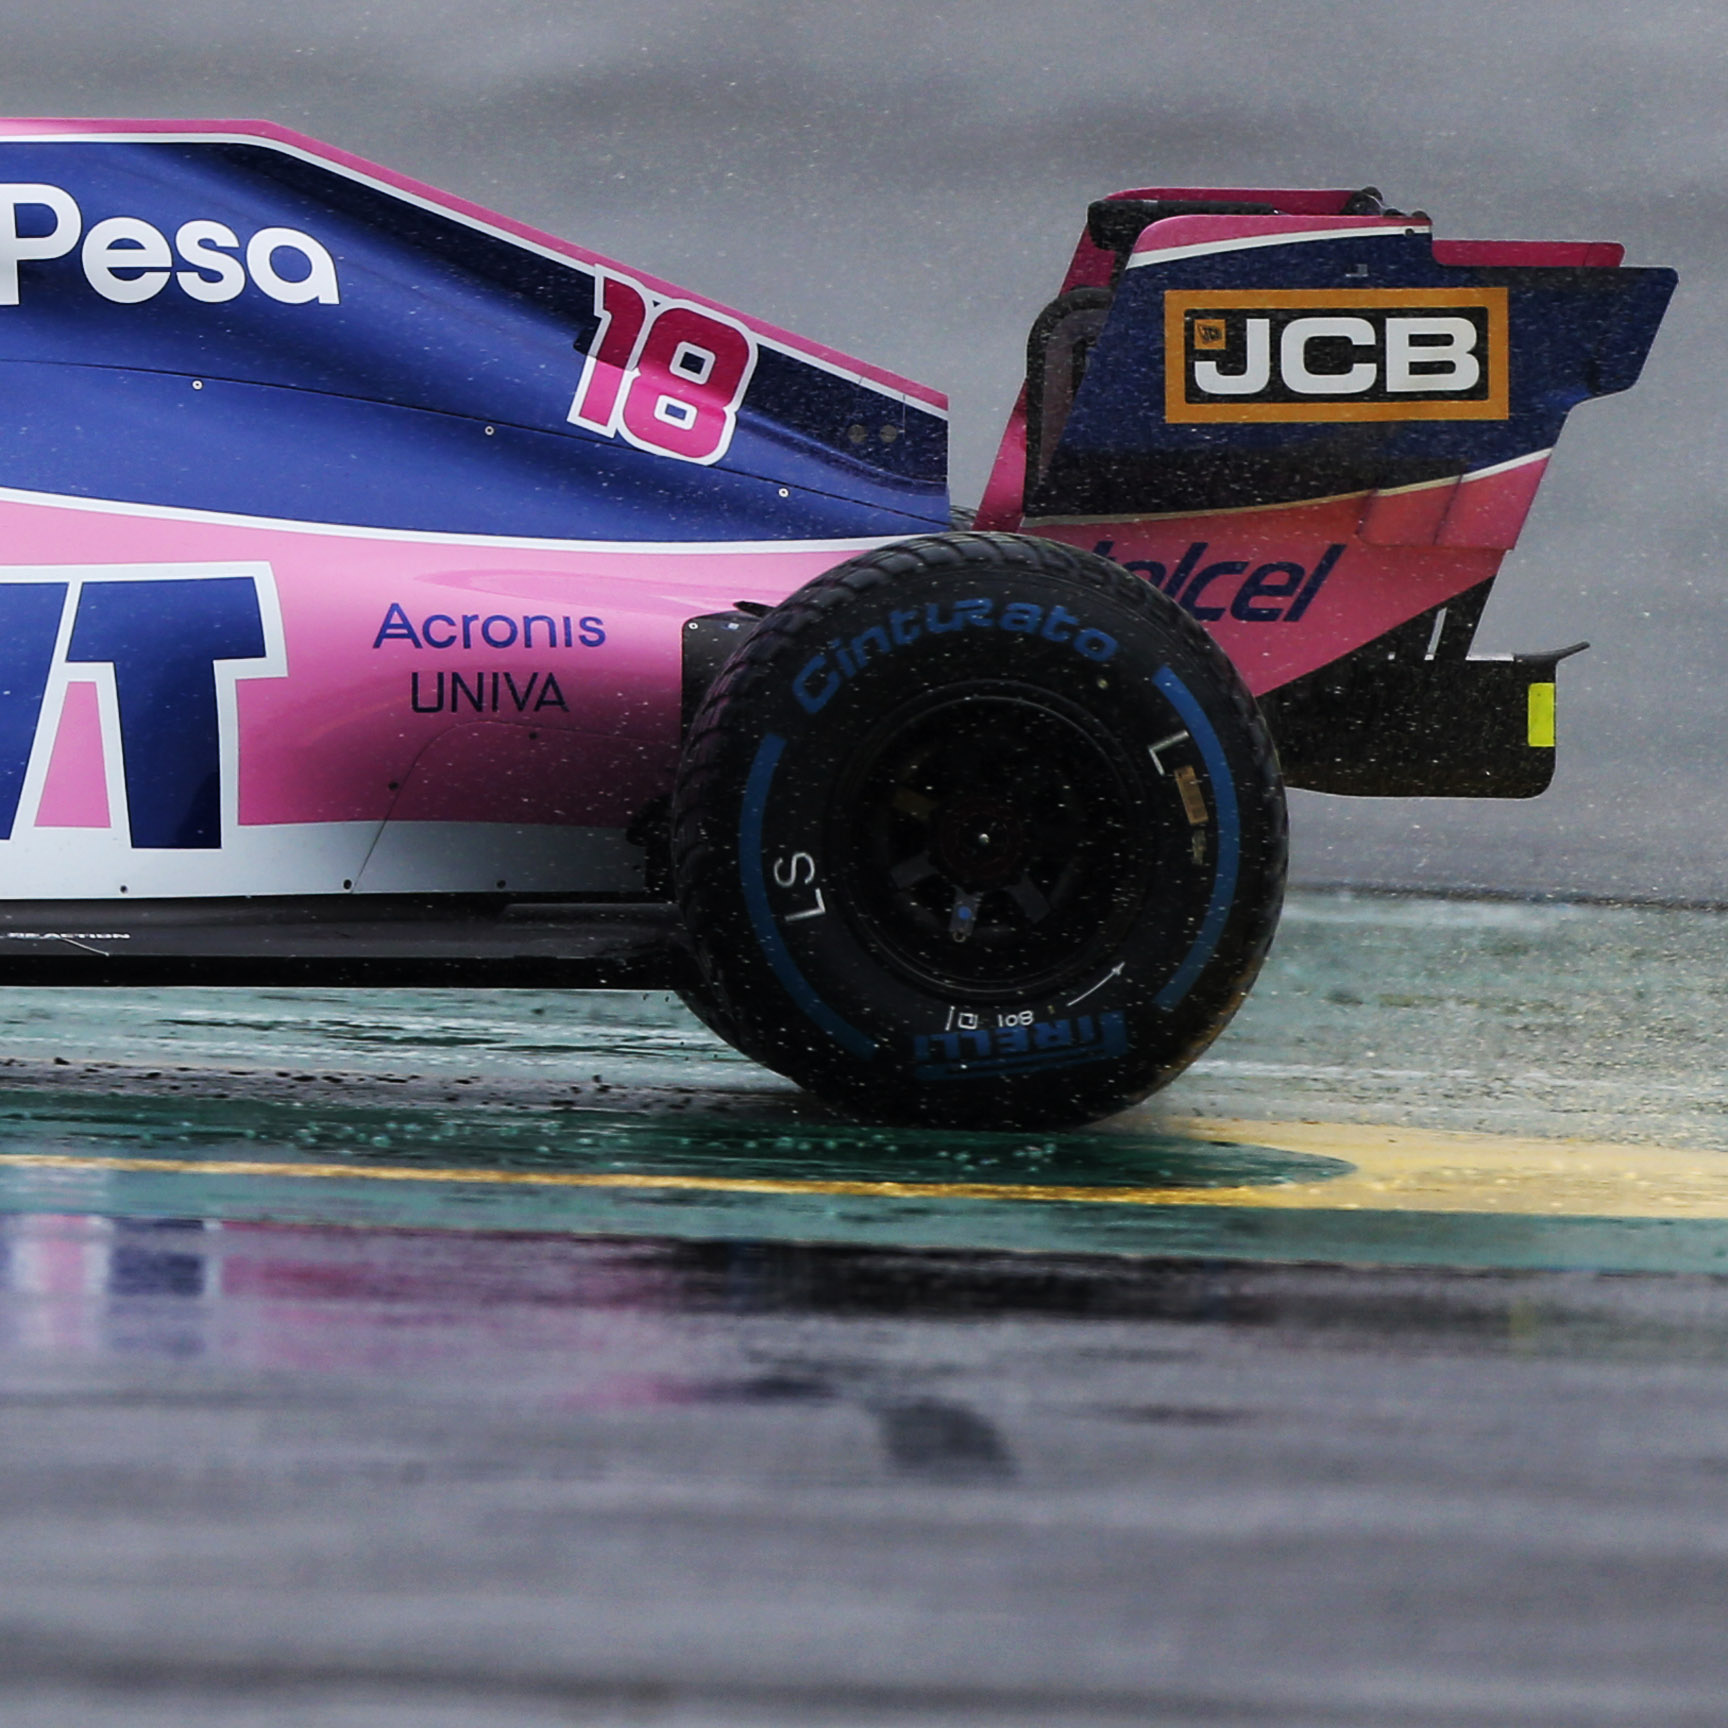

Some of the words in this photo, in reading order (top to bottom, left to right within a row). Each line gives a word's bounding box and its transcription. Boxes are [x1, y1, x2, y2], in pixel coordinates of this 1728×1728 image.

[566, 260, 758, 466] 18
[1194, 317, 1480, 394] JCB
[372, 602, 606, 649] Acronis
[792, 597, 1119, 714] Cinturato
[411, 672, 570, 713] UNIVA
[913, 1010, 1128, 1080] PIRELLI
